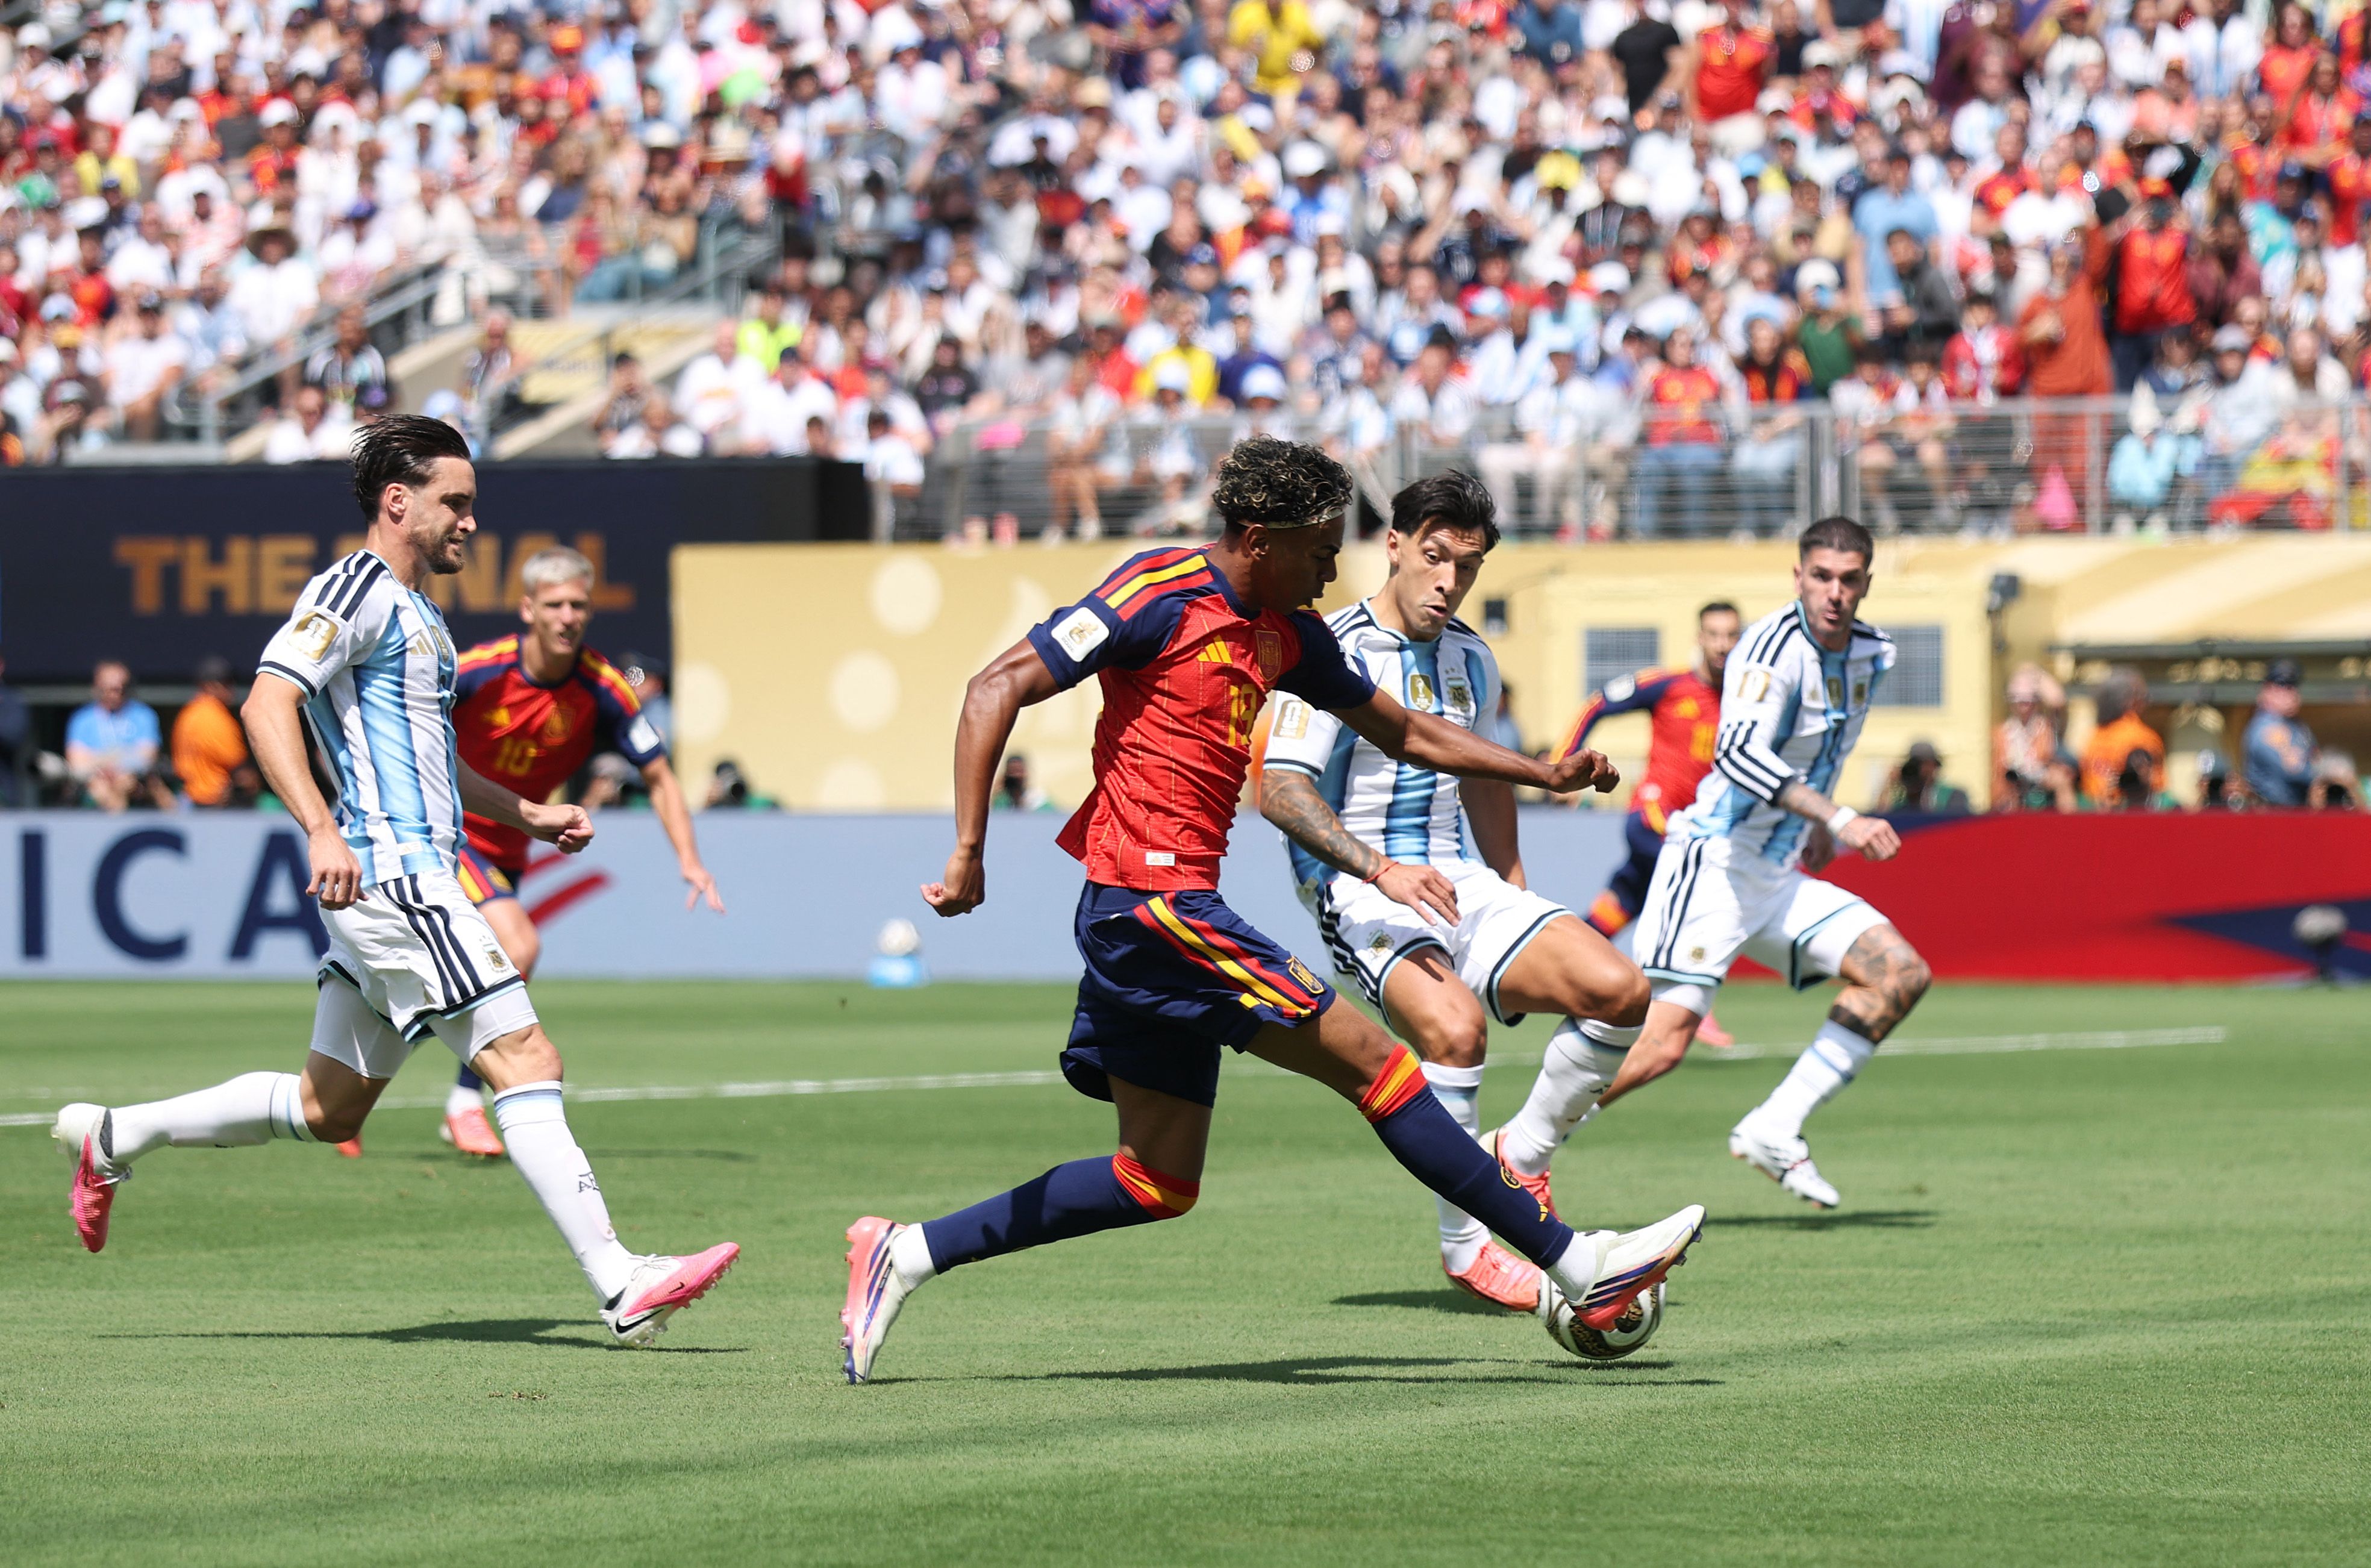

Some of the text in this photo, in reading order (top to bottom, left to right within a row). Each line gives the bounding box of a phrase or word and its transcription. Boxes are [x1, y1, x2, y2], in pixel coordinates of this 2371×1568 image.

[113, 534, 316, 614] THE
[1228, 684, 1257, 746] 19
[494, 736, 537, 776] 10
